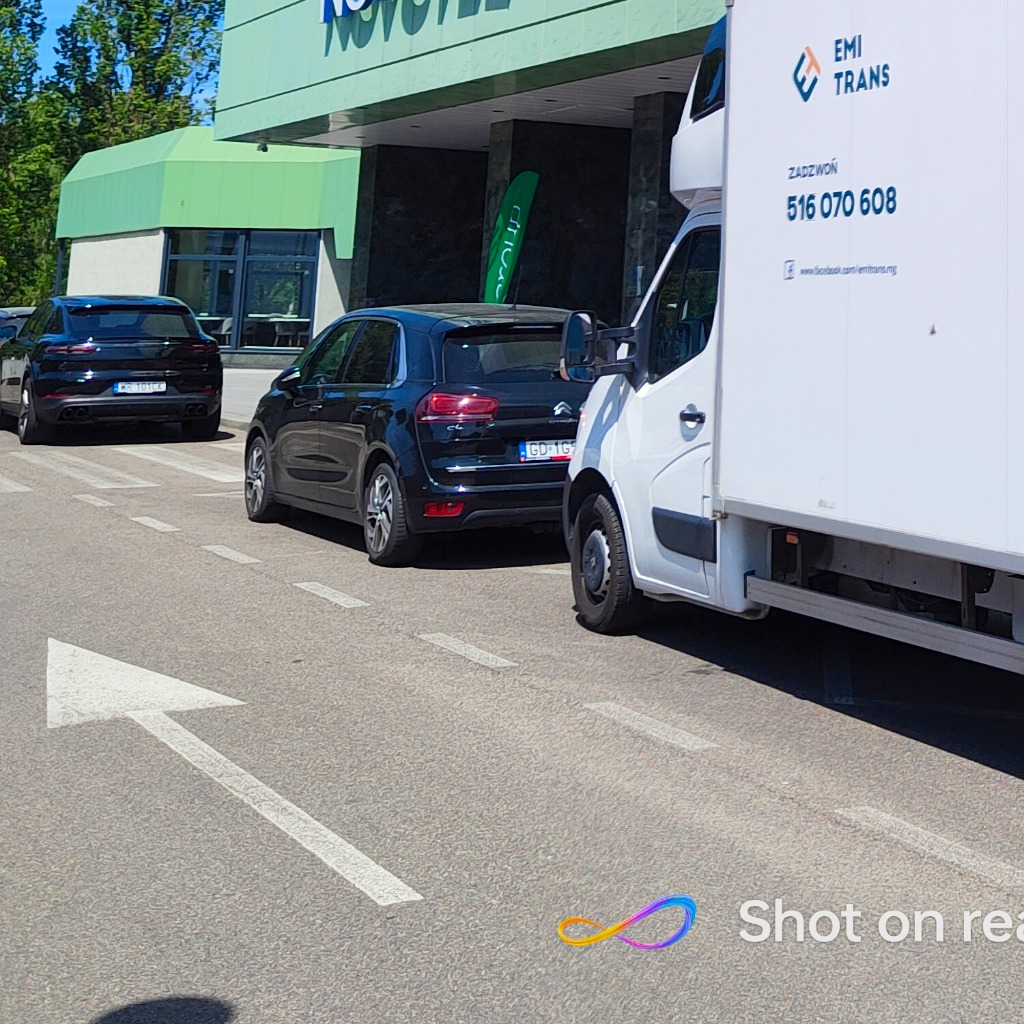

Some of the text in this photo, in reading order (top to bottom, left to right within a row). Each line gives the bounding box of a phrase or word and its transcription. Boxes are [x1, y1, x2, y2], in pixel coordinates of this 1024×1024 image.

[833, 34, 862, 63] EMI
[833, 63, 890, 96] TRANS
[787, 157, 838, 180] ZADZWOŃ
[787, 186, 897, 221] 516 070 608
[530, 442, 548, 456] GD
